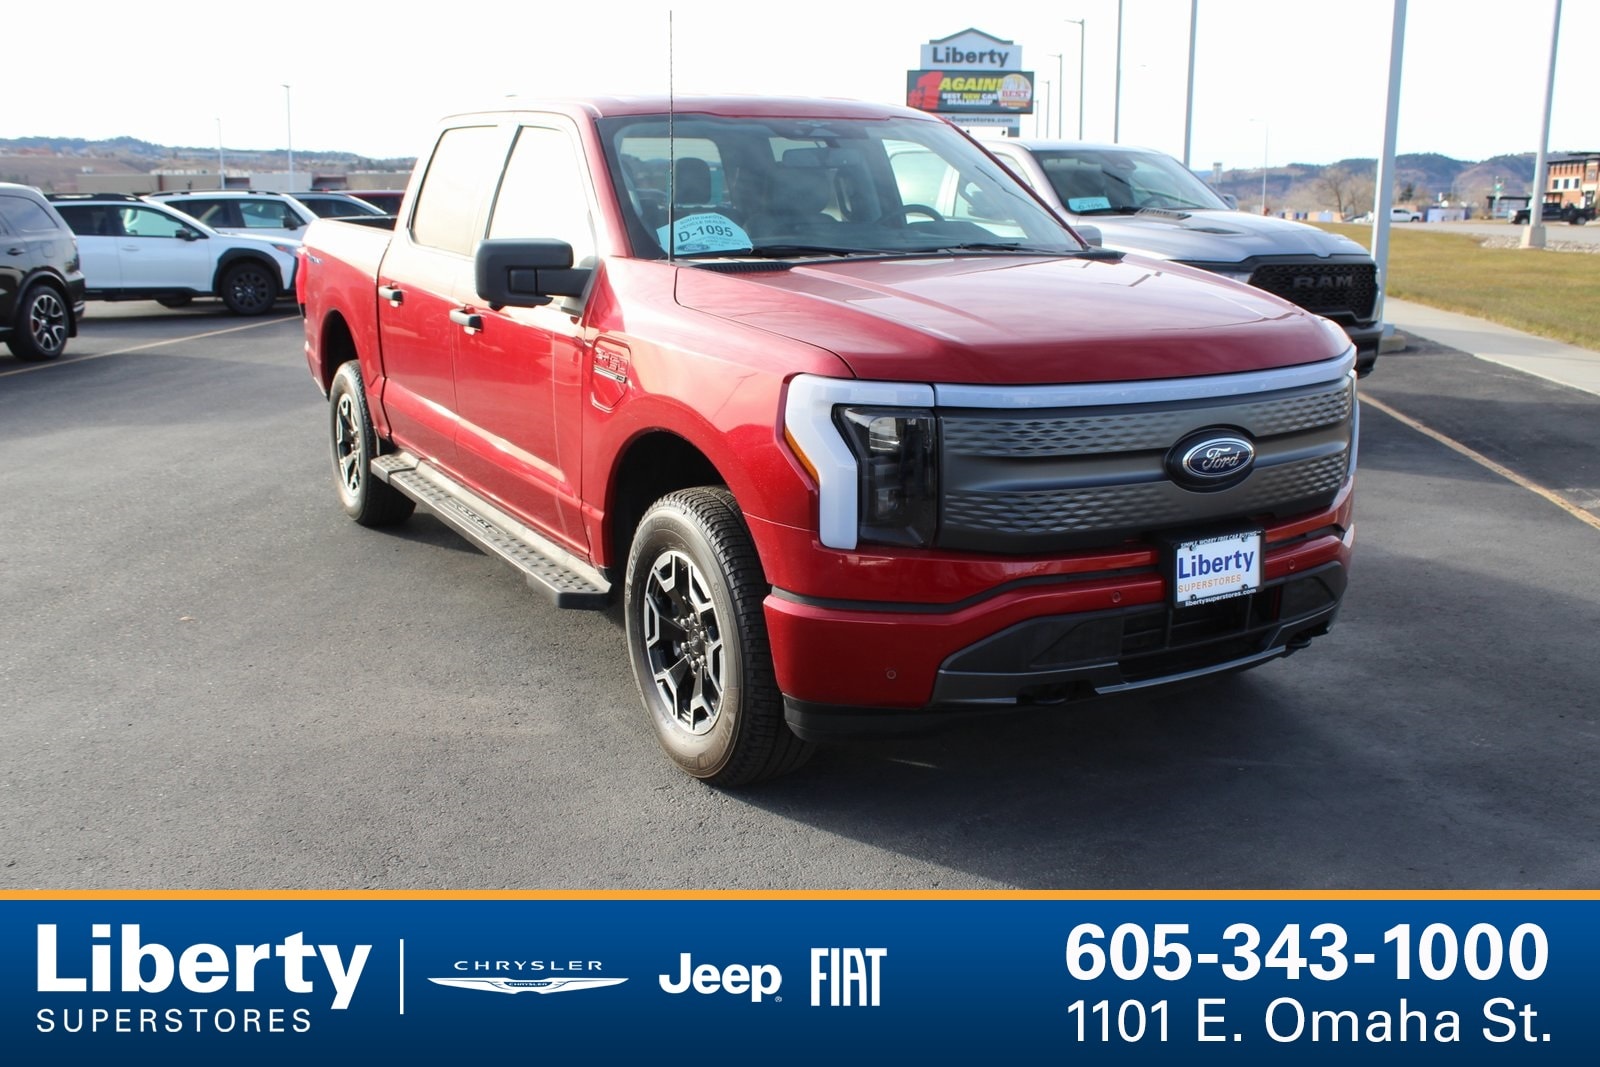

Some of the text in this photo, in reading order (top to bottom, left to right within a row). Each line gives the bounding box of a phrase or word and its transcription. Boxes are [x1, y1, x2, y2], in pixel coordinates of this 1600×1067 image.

[932, 47, 1009, 67] Liberty
[678, 224, 734, 243] D-1095
[1293, 275, 1353, 289] RAM
[1201, 447, 1241, 471] Ford
[1178, 550, 1254, 579] Liberty
[1178, 574, 1242, 594] SUPERSTORES
[1185, 588, 1257, 607] libertysuperstores.com
